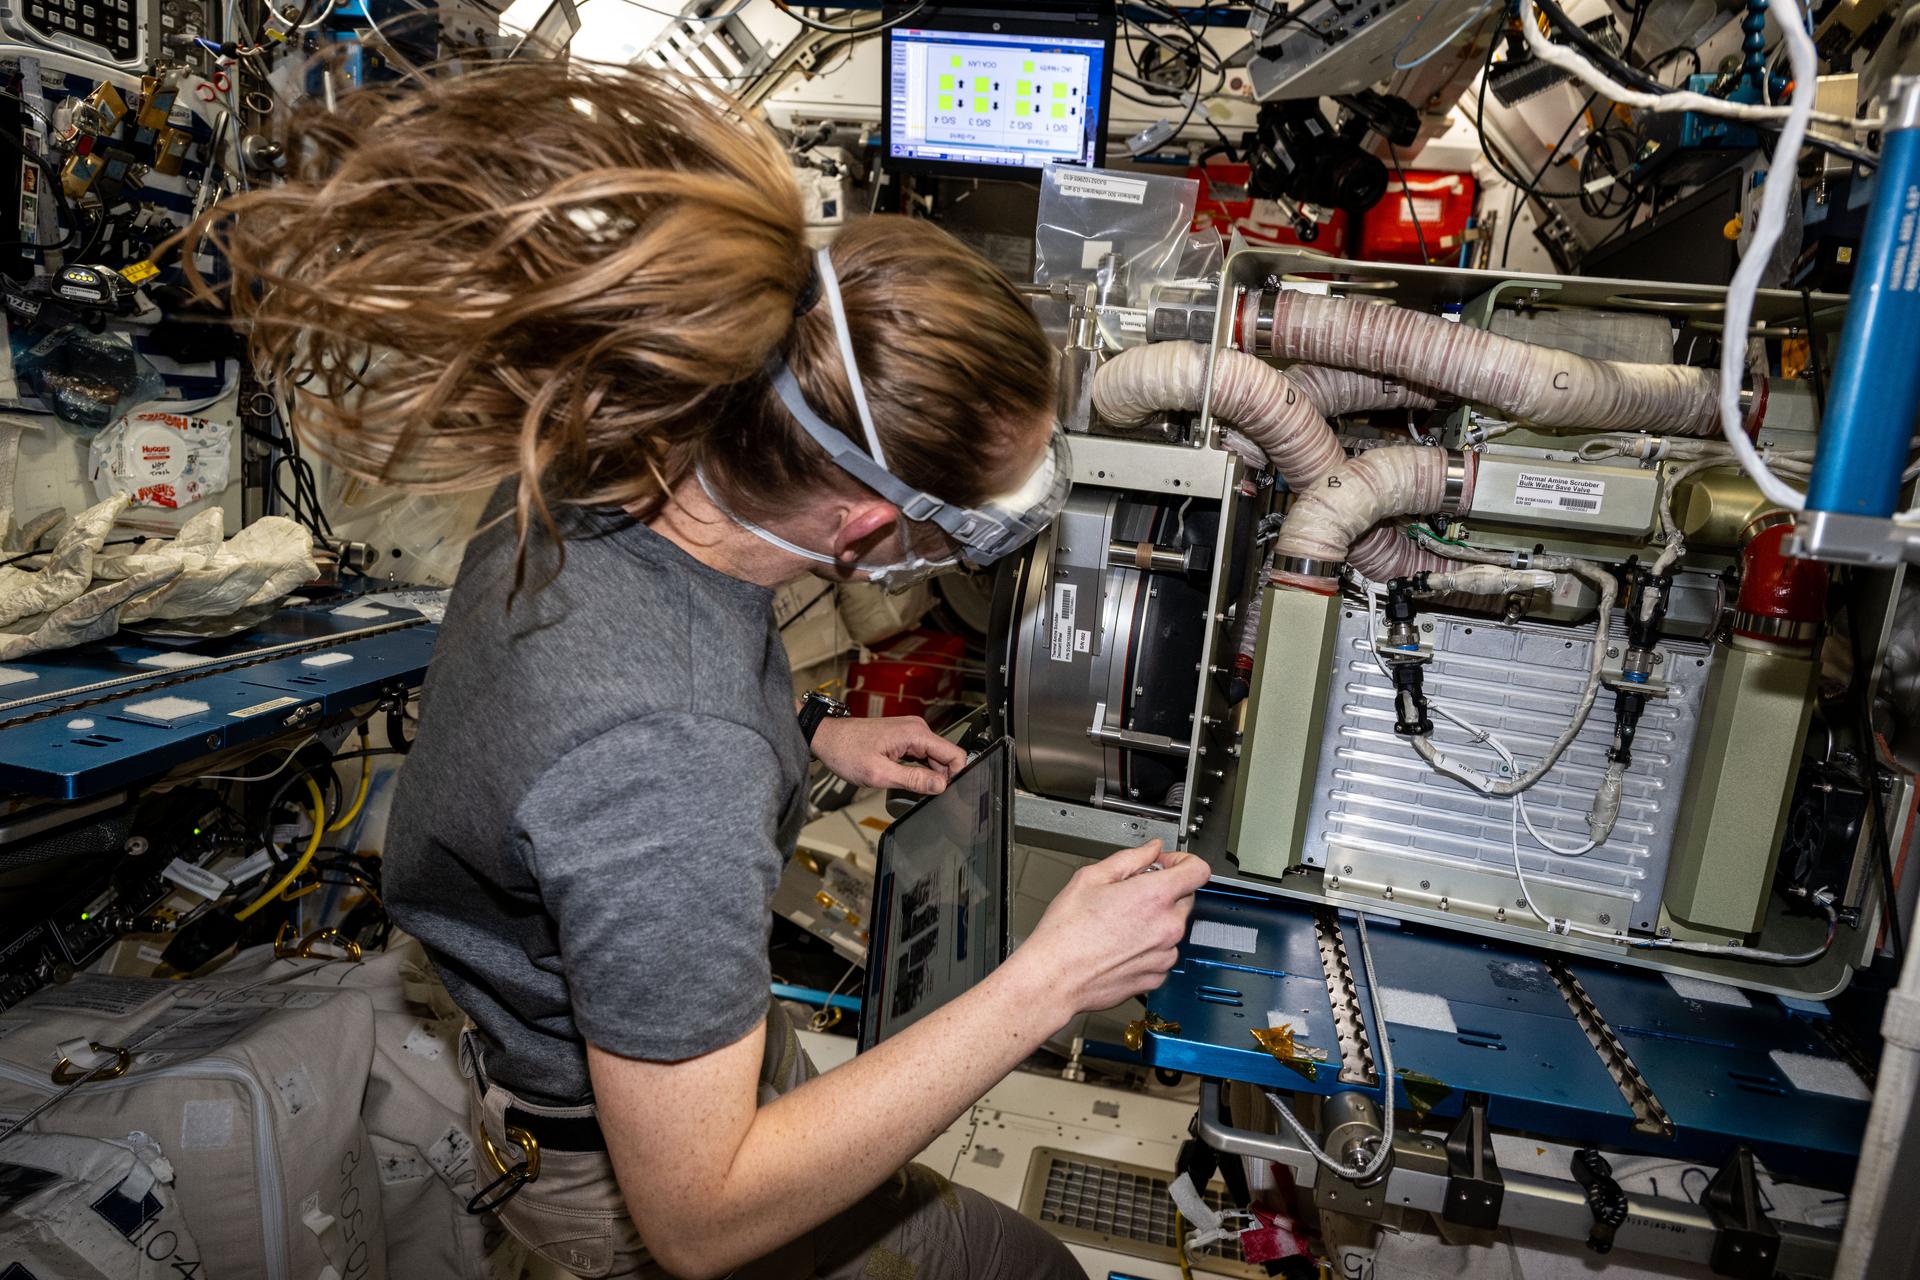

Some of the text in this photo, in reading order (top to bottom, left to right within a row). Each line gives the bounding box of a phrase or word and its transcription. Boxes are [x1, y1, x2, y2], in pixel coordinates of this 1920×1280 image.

[941, 116, 957, 125] S/G
[968, 118, 991, 127] S/G 3
[1009, 121, 1033, 130] S/G 2
[6, 294, 41, 314] PETZL
[1553, 371, 1569, 390] C
[1286, 388, 1296, 405] D
[151, 461, 166, 470] NOT
[1328, 476, 1342, 489] B
[1520, 474, 1547, 482] Thermal
[1569, 480, 1600, 488] Scrubber
